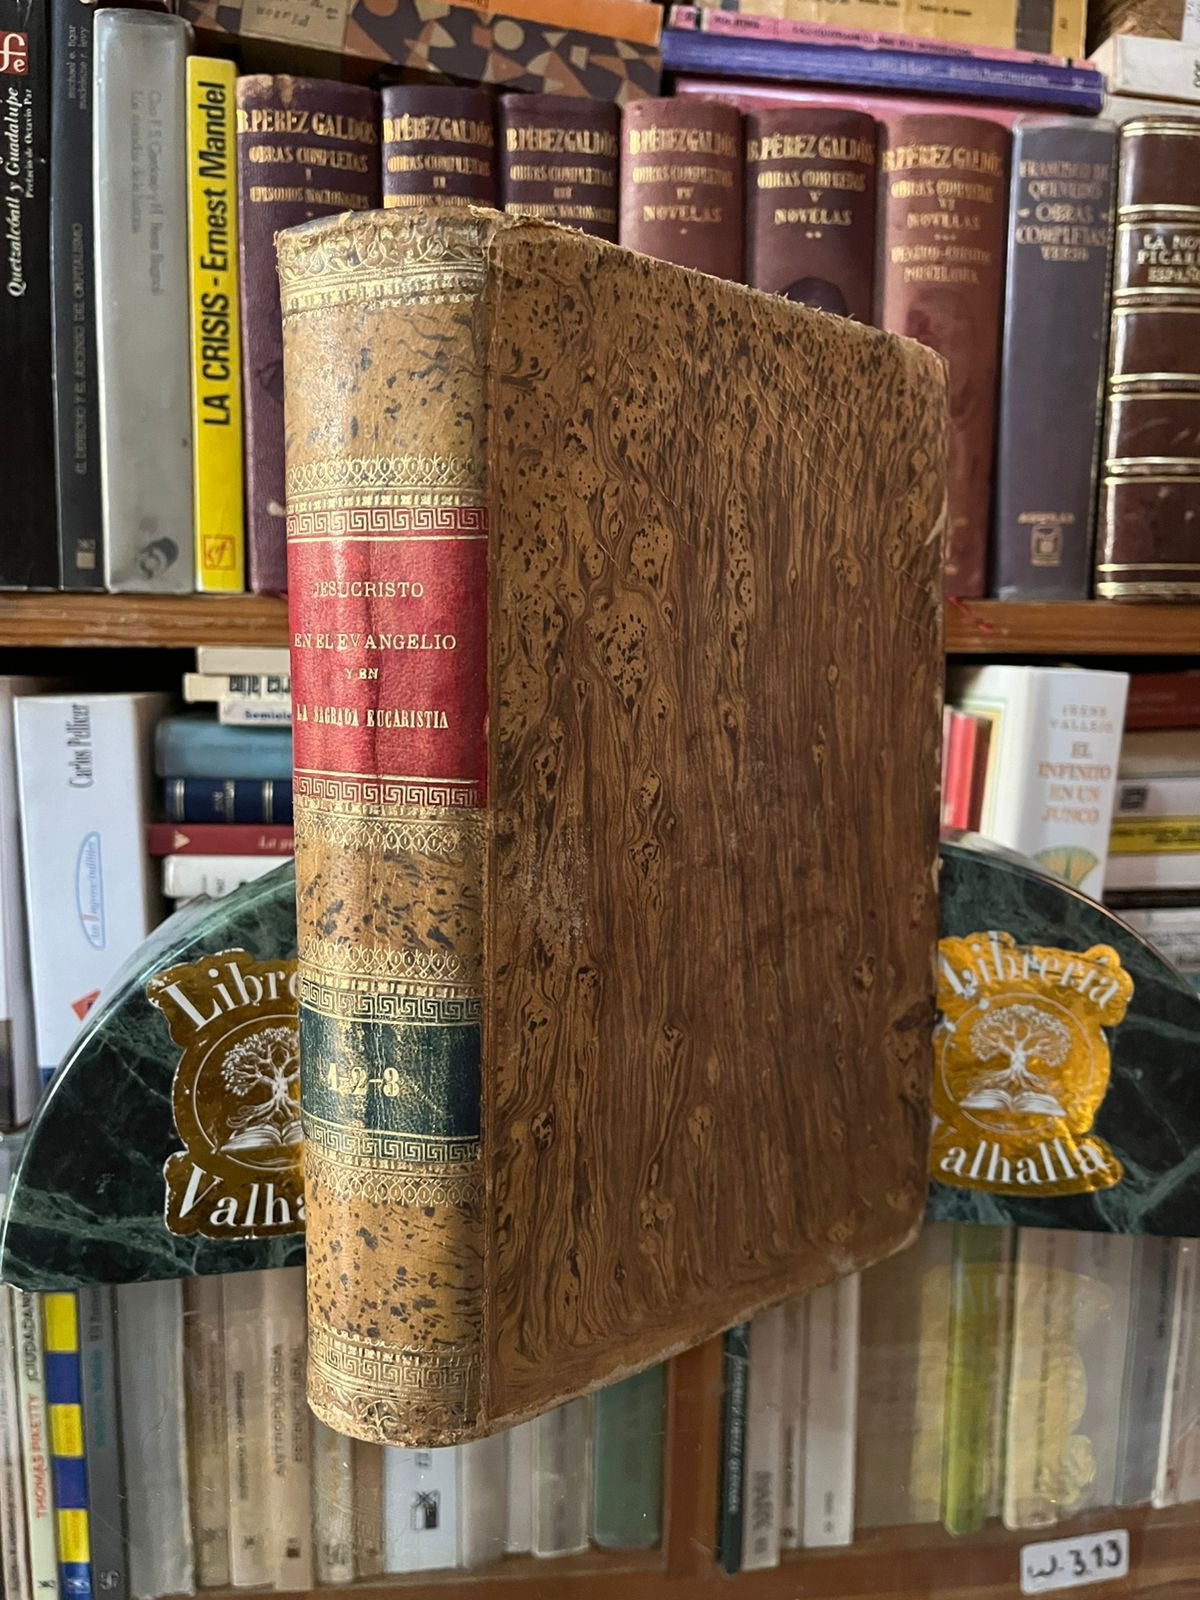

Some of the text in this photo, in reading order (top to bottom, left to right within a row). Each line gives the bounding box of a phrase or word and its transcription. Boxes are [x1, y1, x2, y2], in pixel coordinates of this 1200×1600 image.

[5, 87, 23, 176] Guadalupe
[22, 108, 33, 144] Octavio
[197, 80, 228, 180] Mandel
[249, 145, 368, 173] OBRAS COMPLETAS
[9, 182, 24, 193] y
[643, 204, 722, 222] NOVELAS
[774, 208, 852, 226] NOVELAS
[907, 212, 980, 230] NOVELAS
[199, 187, 229, 272] Ernest
[1143, 233, 1166, 250] LA
[200, 292, 230, 382] CRISIS
[202, 394, 231, 426] LA
[314, 581, 424, 599] JESUCRISTO
[294, 633, 457, 650] EN EL EVANGELIO
[344, 668, 353, 680] Y
[296, 703, 449, 729] LA SAGRADA EUCARISTIA
[68, 750, 94, 788] Carlos
[28, 1394, 45, 1450] PIKETTY
[32, 1455, 48, 1518] THOMAS
